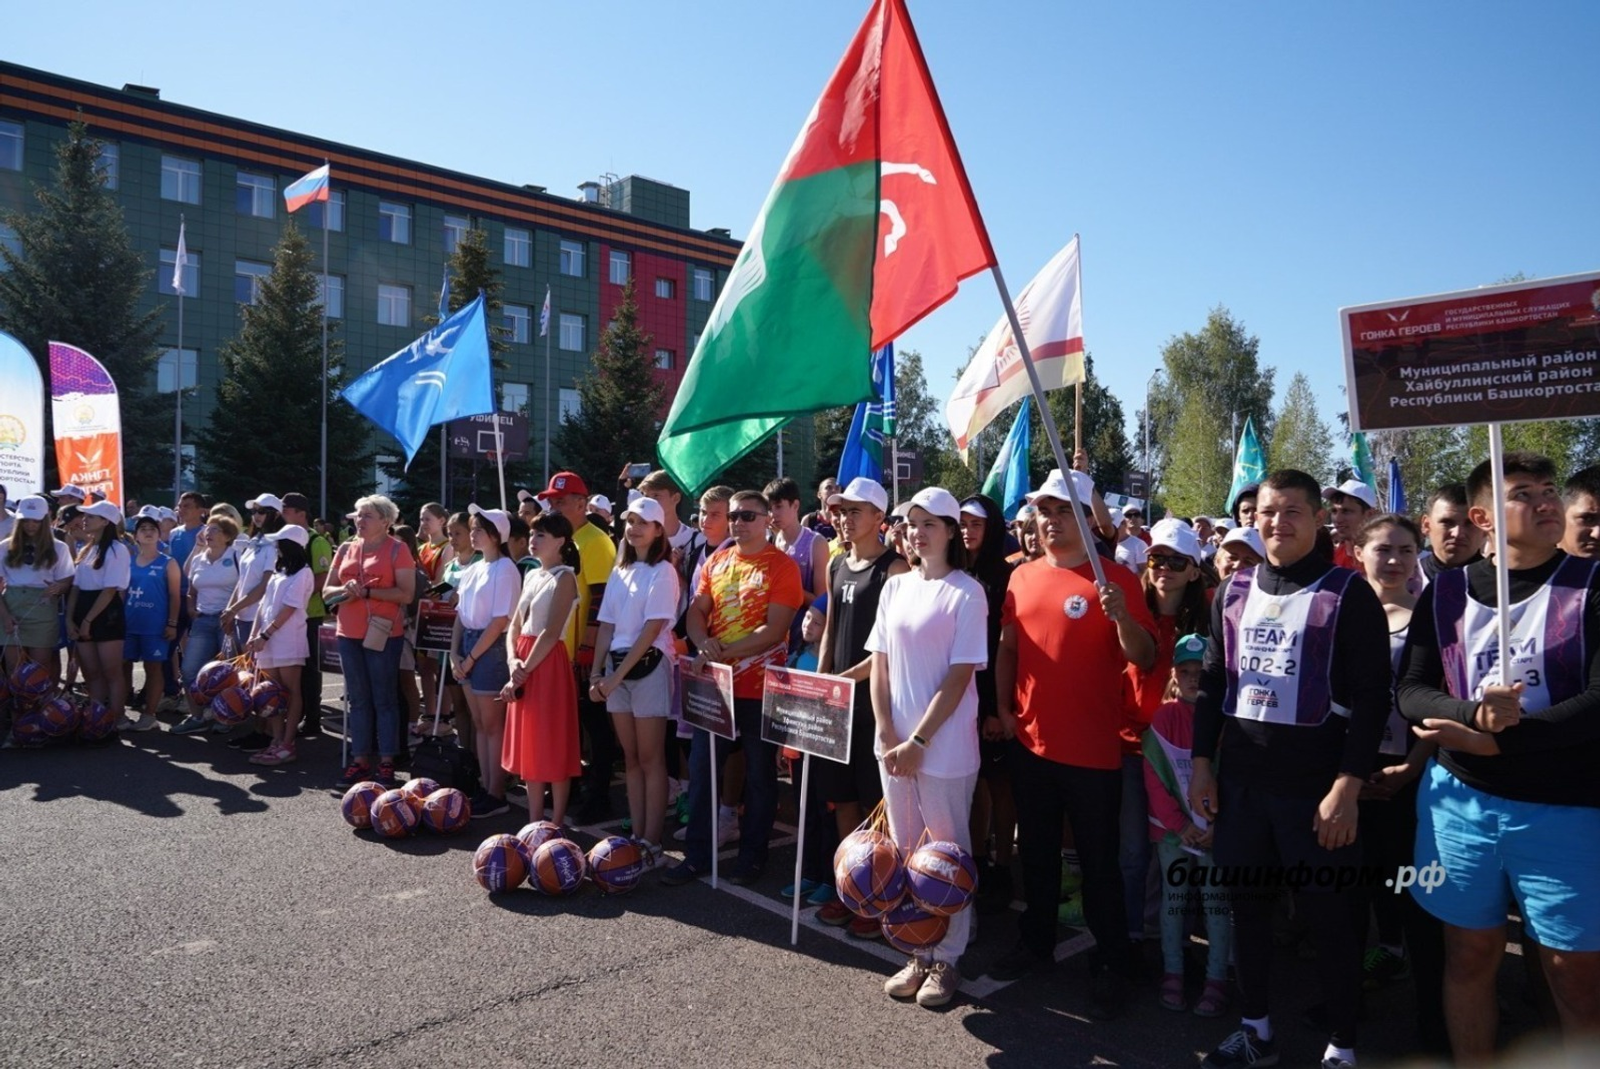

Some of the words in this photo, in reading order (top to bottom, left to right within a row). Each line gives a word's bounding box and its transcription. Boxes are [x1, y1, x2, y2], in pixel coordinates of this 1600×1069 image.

[1360, 328, 1396, 341] ГОНКА
[1398, 322, 1442, 336] ГЕРОЕВ
[1400, 354, 1537, 379] Муниципальный
[1541, 350, 1597, 370] район
[1405, 369, 1533, 394] Хайбуллинский
[1538, 366, 1593, 386] район
[1390, 390, 1483, 410] Республики
[841, 584, 856, 604] 14
[1243, 627, 1298, 647] TEAM
[1473, 637, 1536, 670] TEM
[1240, 655, 1297, 676] 002-2
